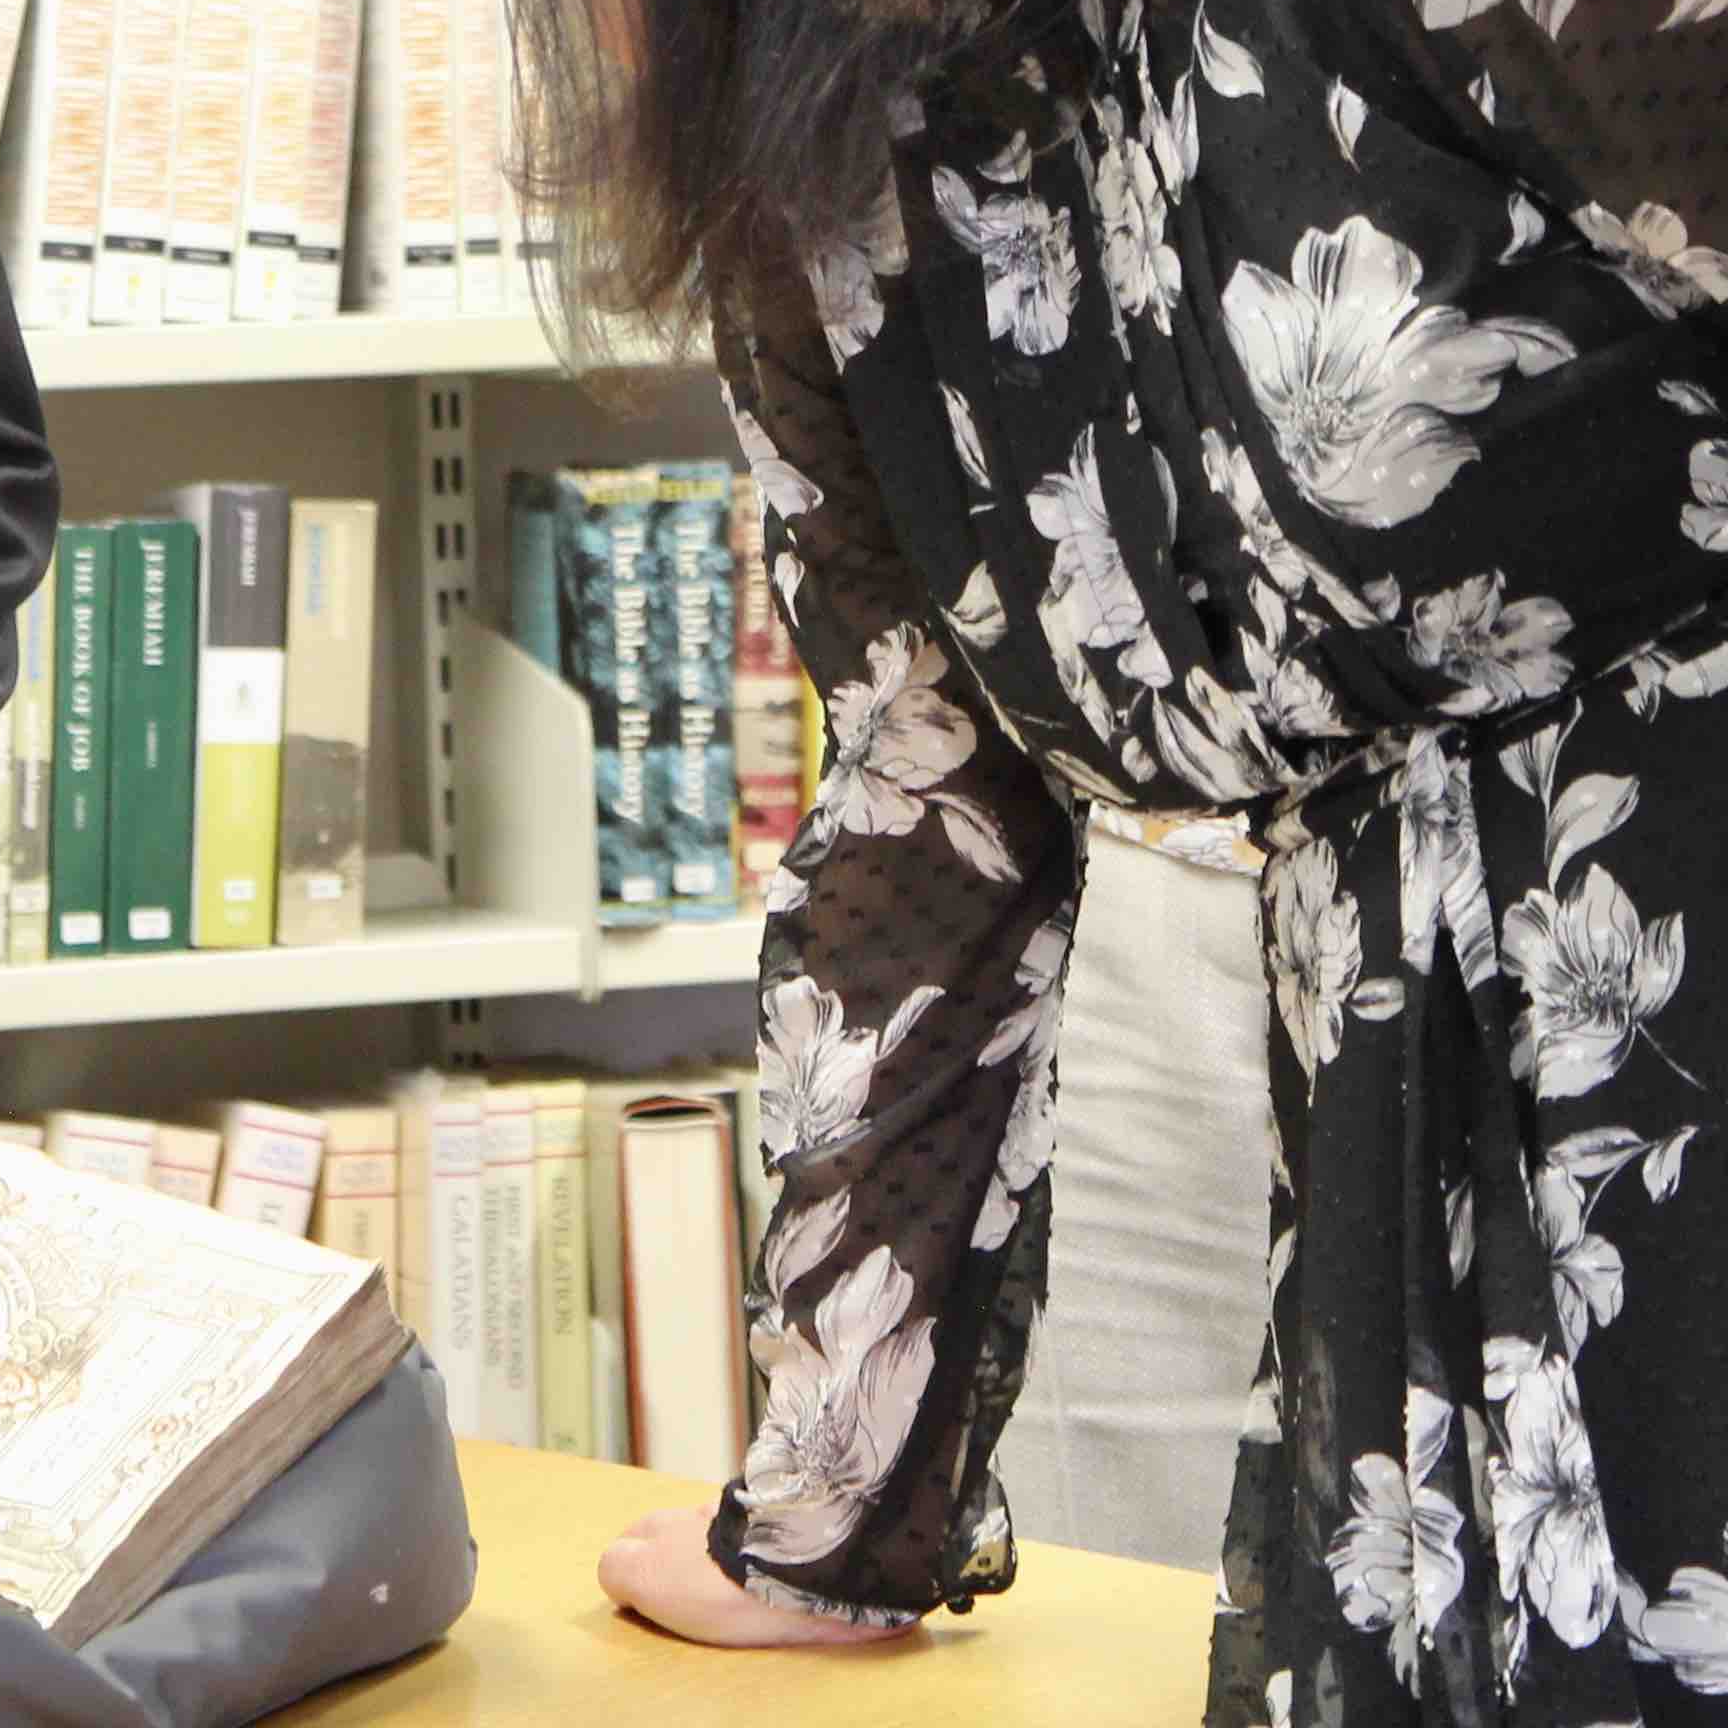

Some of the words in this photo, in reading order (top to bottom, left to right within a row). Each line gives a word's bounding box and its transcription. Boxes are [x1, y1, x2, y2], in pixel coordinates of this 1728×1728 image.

[73, 548, 95, 598] THE
[611, 524, 646, 579] The
[673, 521, 710, 578] The
[138, 538, 164, 665] JEREMIAH
[612, 584, 649, 663] Bible
[675, 582, 712, 658] Bible
[71, 603, 94, 677] BOOK
[71, 680, 92, 713] OF
[616, 666, 640, 704] as
[677, 664, 703, 700] as
[65, 721, 90, 770] JOB
[609, 705, 653, 824] History
[670, 703, 716, 819] History
[446, 1192, 476, 1351] GALATIANS
[546, 1174, 576, 1337] REVELATION
